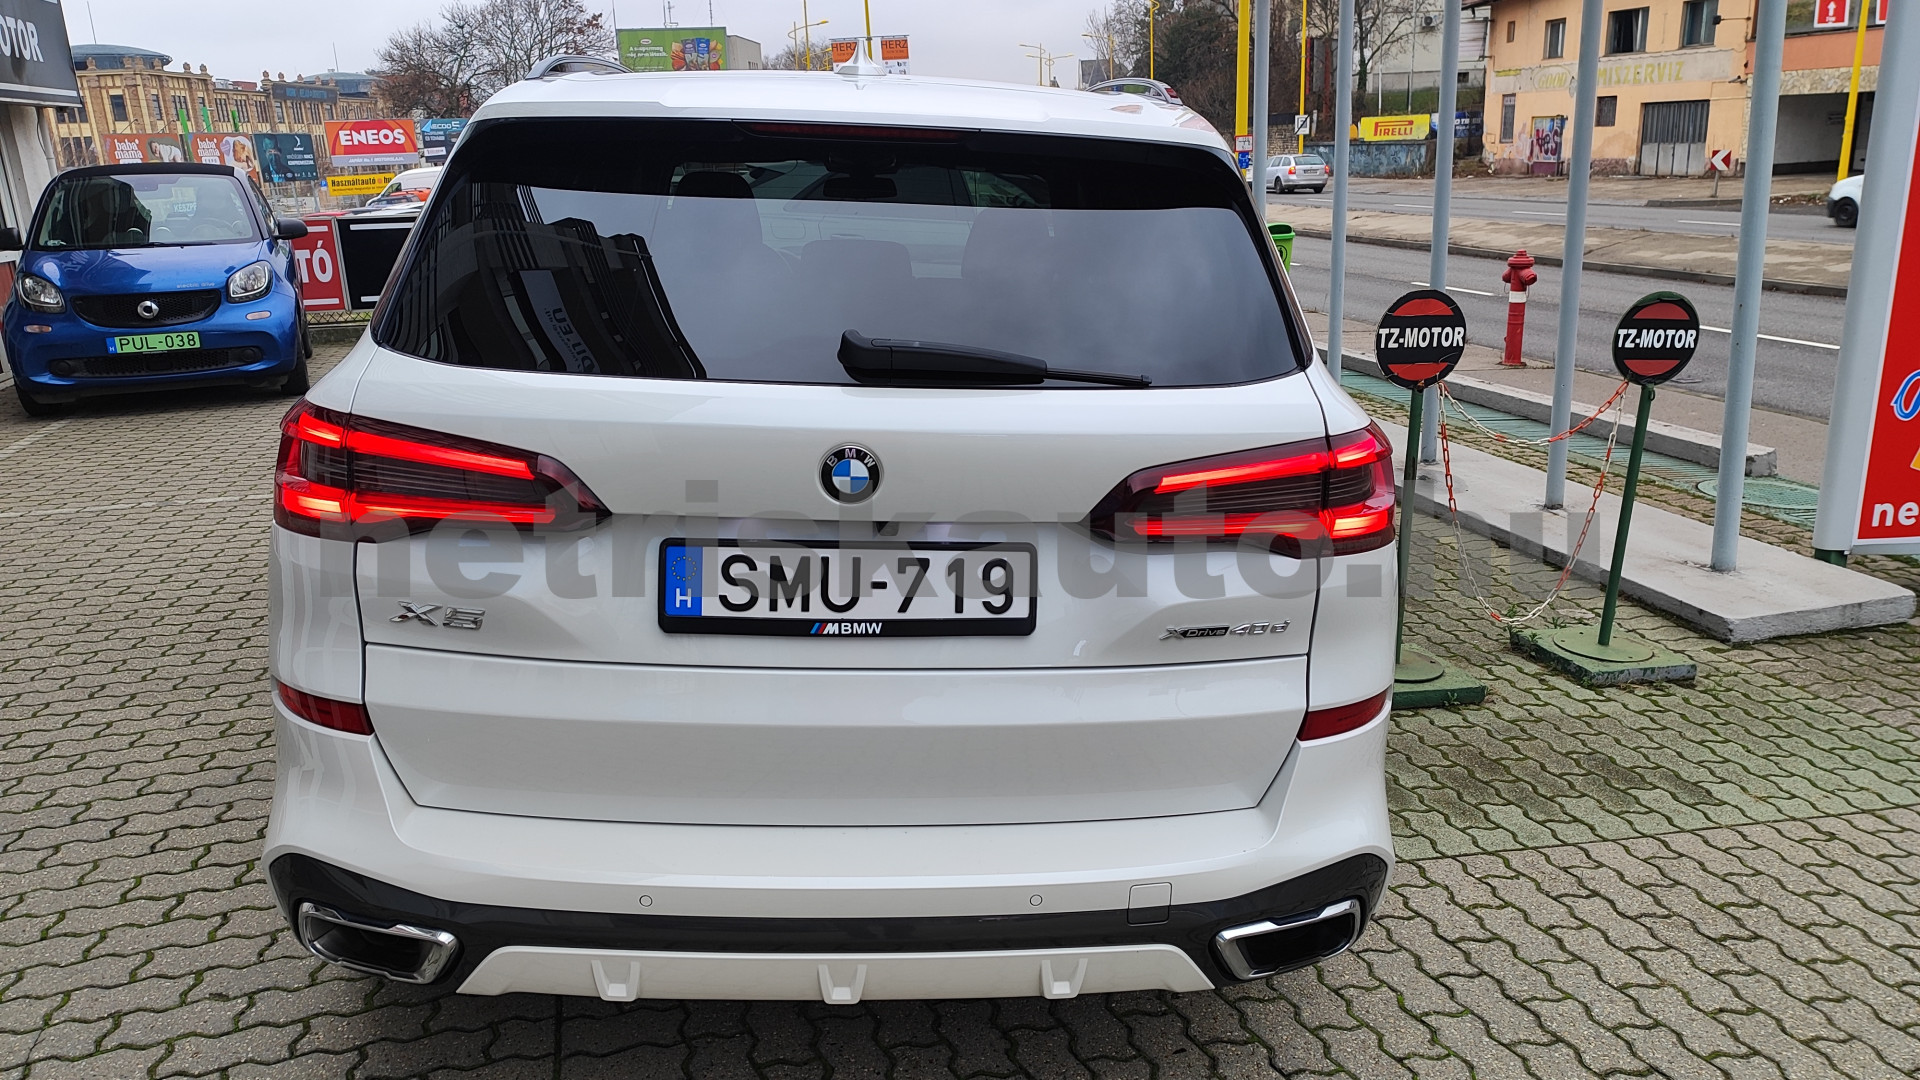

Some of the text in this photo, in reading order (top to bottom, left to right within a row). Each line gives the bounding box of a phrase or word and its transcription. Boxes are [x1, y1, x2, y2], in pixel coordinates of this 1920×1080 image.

[881, 39, 908, 49] HERZ
[338, 128, 406, 146] ENEOS
[1373, 119, 1414, 137] PIRELLI
[114, 138, 139, 151] baba
[197, 137, 217, 149] baba
[197, 147, 220, 157] mama
[115, 149, 143, 159] mama
[331, 177, 376, 187] Használtautó
[295, 240, 333, 283] TÓ
[119, 334, 196, 351] PUL-038
[1378, 326, 1464, 349] TZ-MOTOR
[1617, 328, 1697, 349] TZ-MOTOR
[825, 447, 876, 469] BMW
[1871, 501, 1920, 527] ne
[675, 553, 1014, 615] H SMU-719
[389, 600, 487, 631] X5
[840, 622, 883, 635] BMW
